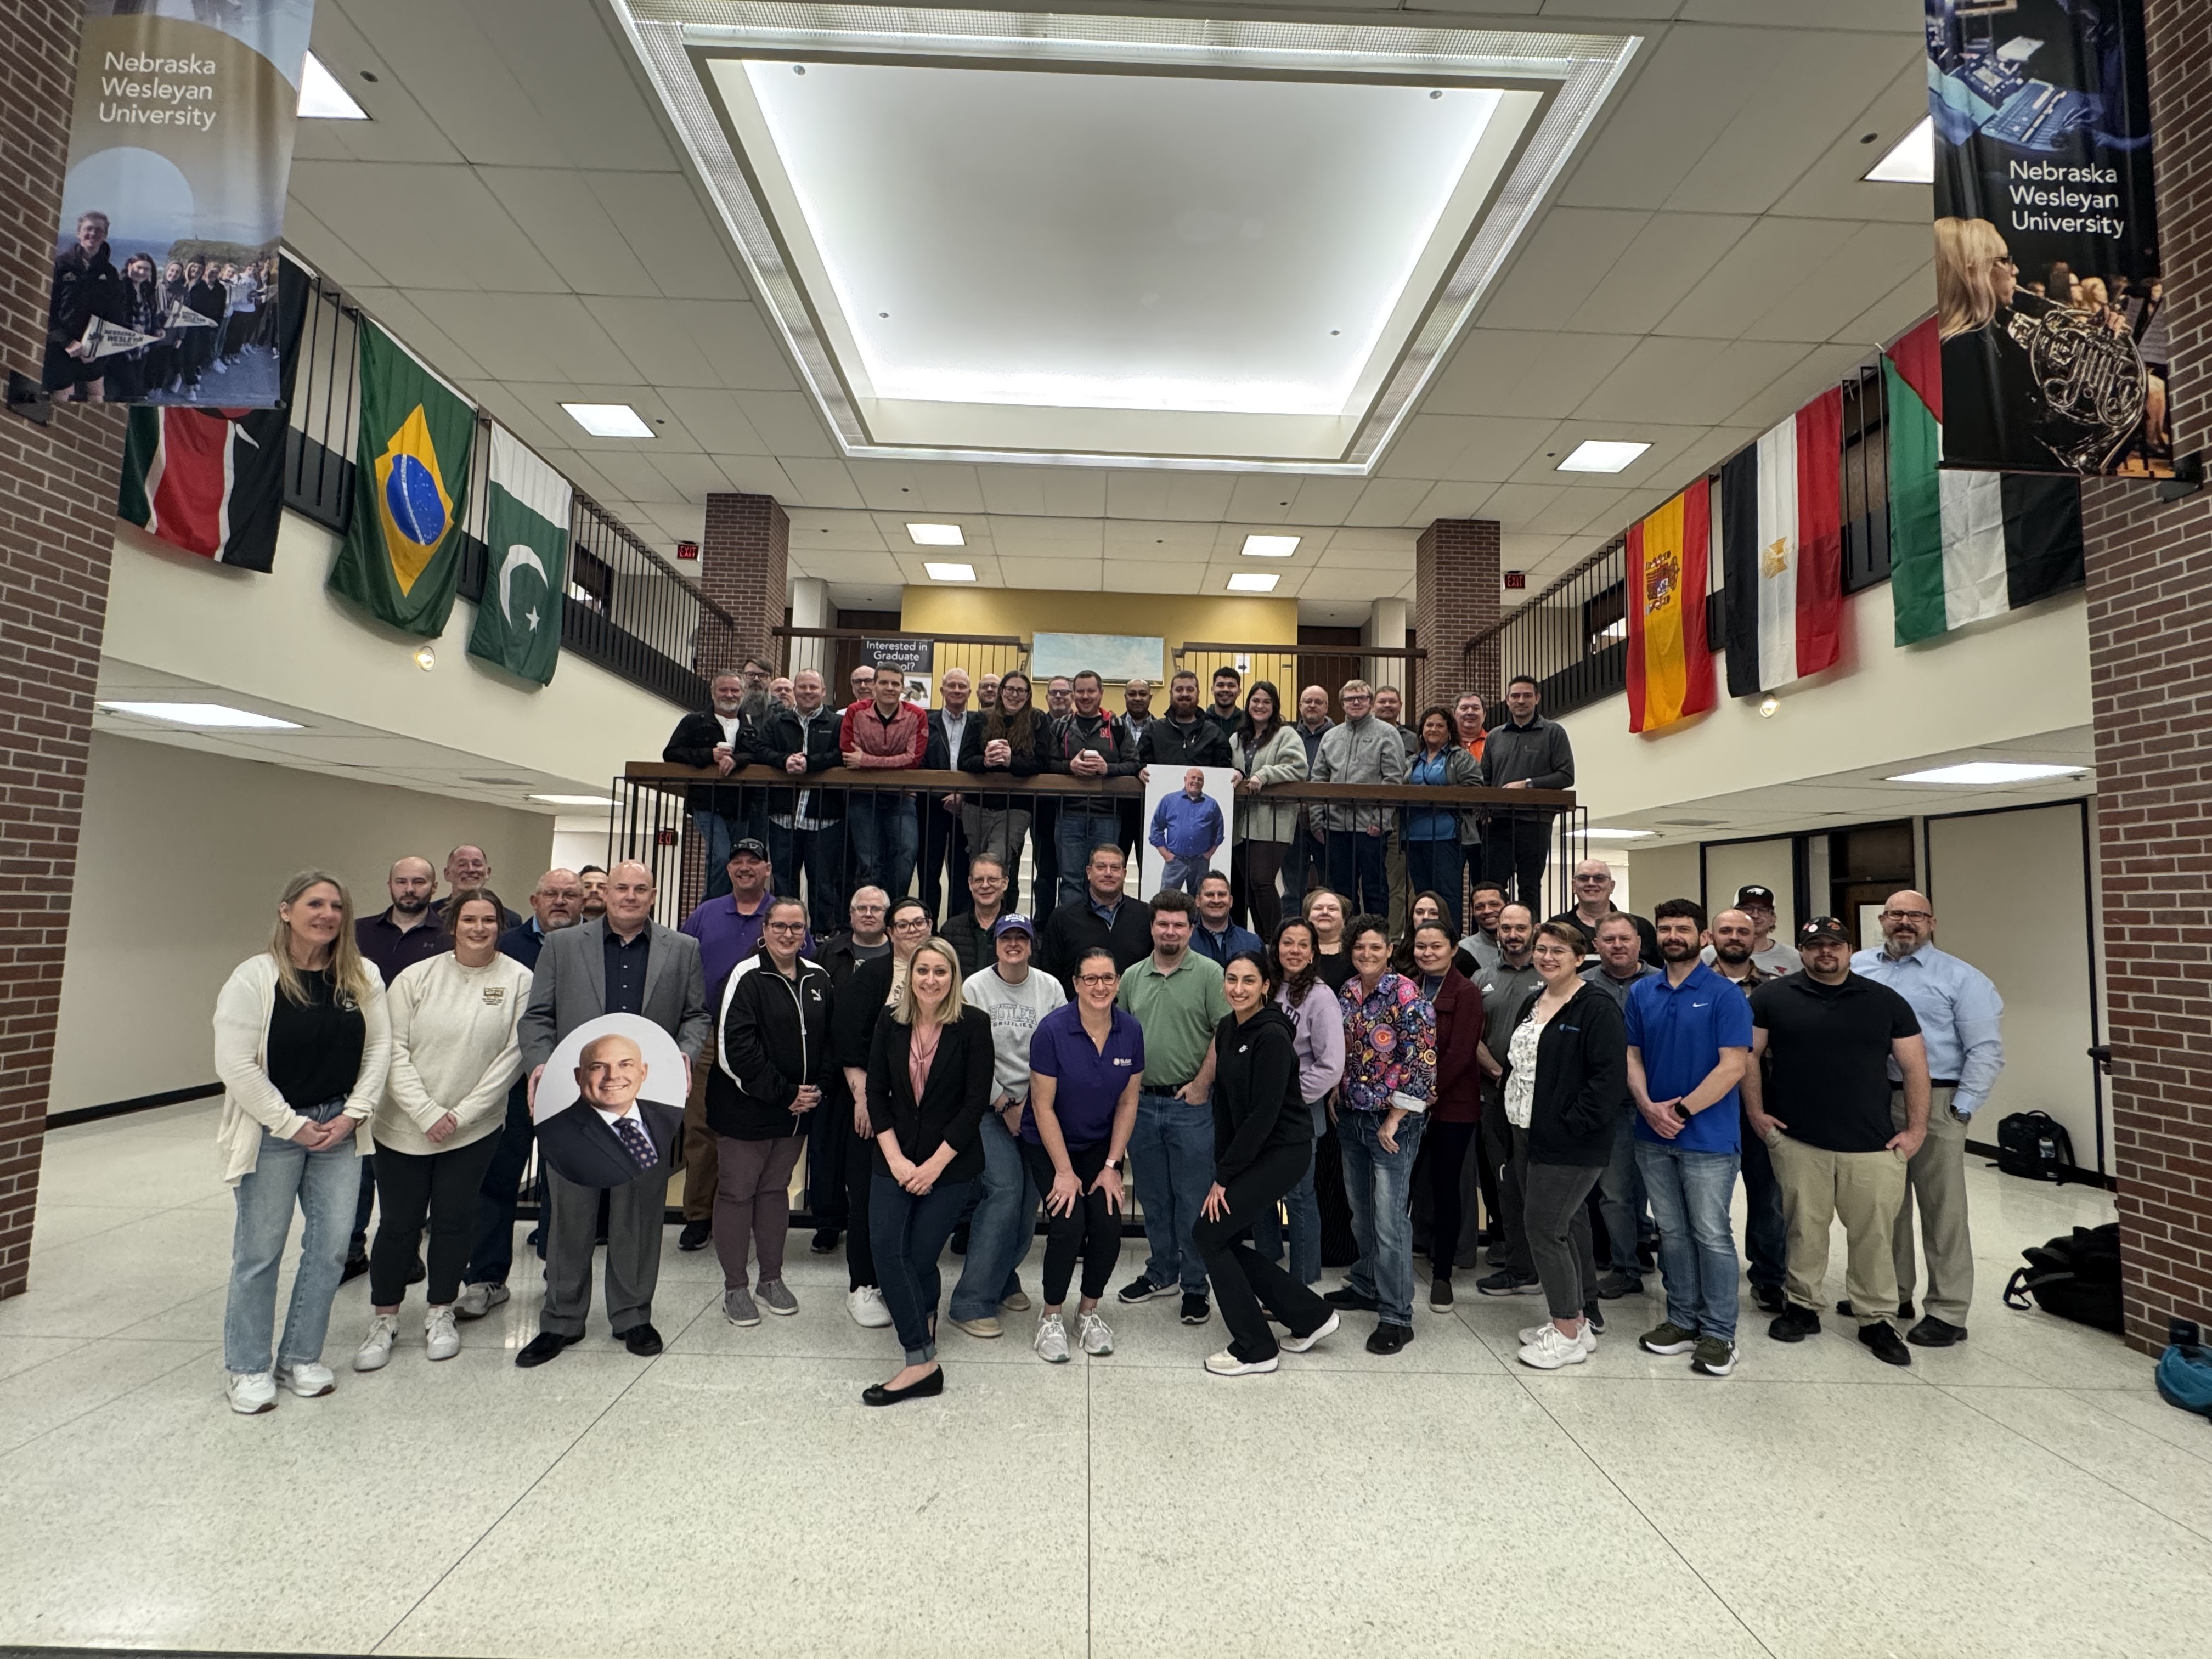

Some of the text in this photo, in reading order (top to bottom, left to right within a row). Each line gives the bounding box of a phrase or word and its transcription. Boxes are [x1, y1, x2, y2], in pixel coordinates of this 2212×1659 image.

[104, 50, 216, 75] Nebraska
[101, 76, 213, 105] Wesleyan
[99, 101, 217, 132] University
[2010, 160, 2118, 183] Nebraska
[2008, 184, 2119, 213] Wesleyan
[2012, 210, 2125, 239] University
[679, 545, 697, 558] EXIT
[1507, 575, 1523, 587] EXIT
[866, 640, 928, 652] Interested in
[873, 651, 920, 661] Graduate
[989, 1003, 1037, 1025] BUTLER
